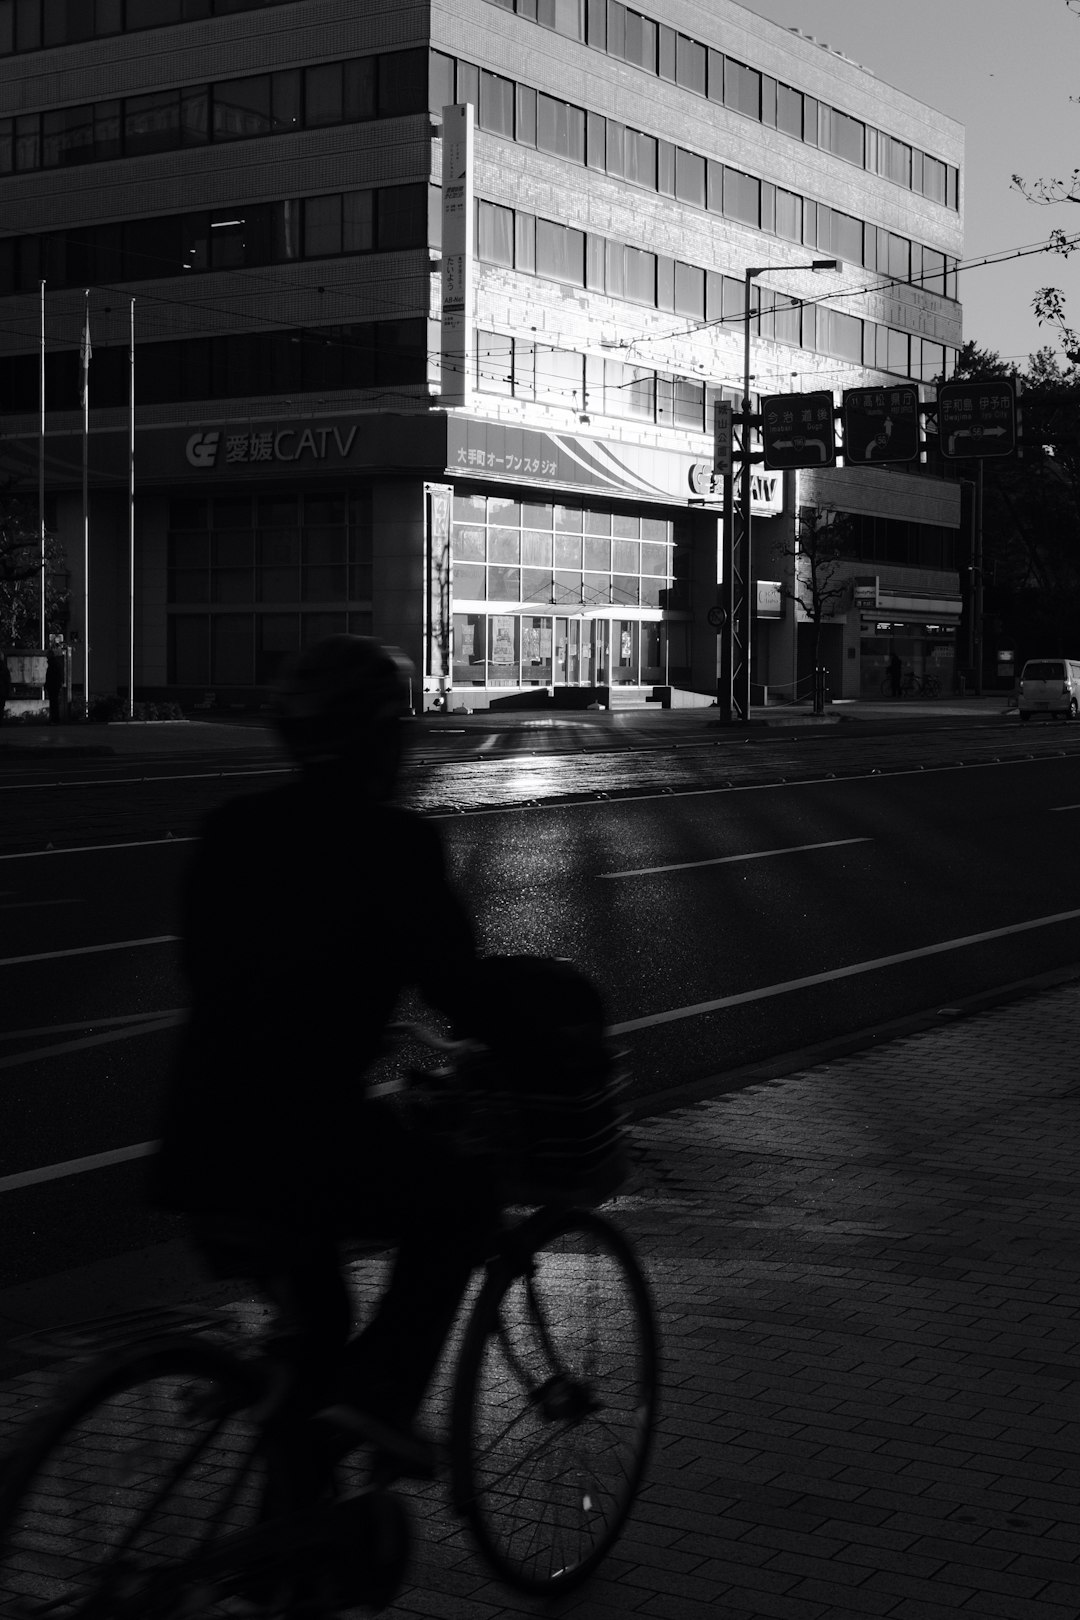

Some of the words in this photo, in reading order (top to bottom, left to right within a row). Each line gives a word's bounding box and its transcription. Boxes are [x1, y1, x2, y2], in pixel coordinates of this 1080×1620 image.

[863, 393, 885, 407] 高松
[943, 398, 972, 412] 宇和島
[980, 396, 1010, 410] 伊予市
[768, 411, 794, 424] 今治
[801, 408, 828, 422] 道後
[226, 425, 357, 463] 愛媛CATV
[457, 447, 557, 476] 大手町オープンスタジオ
